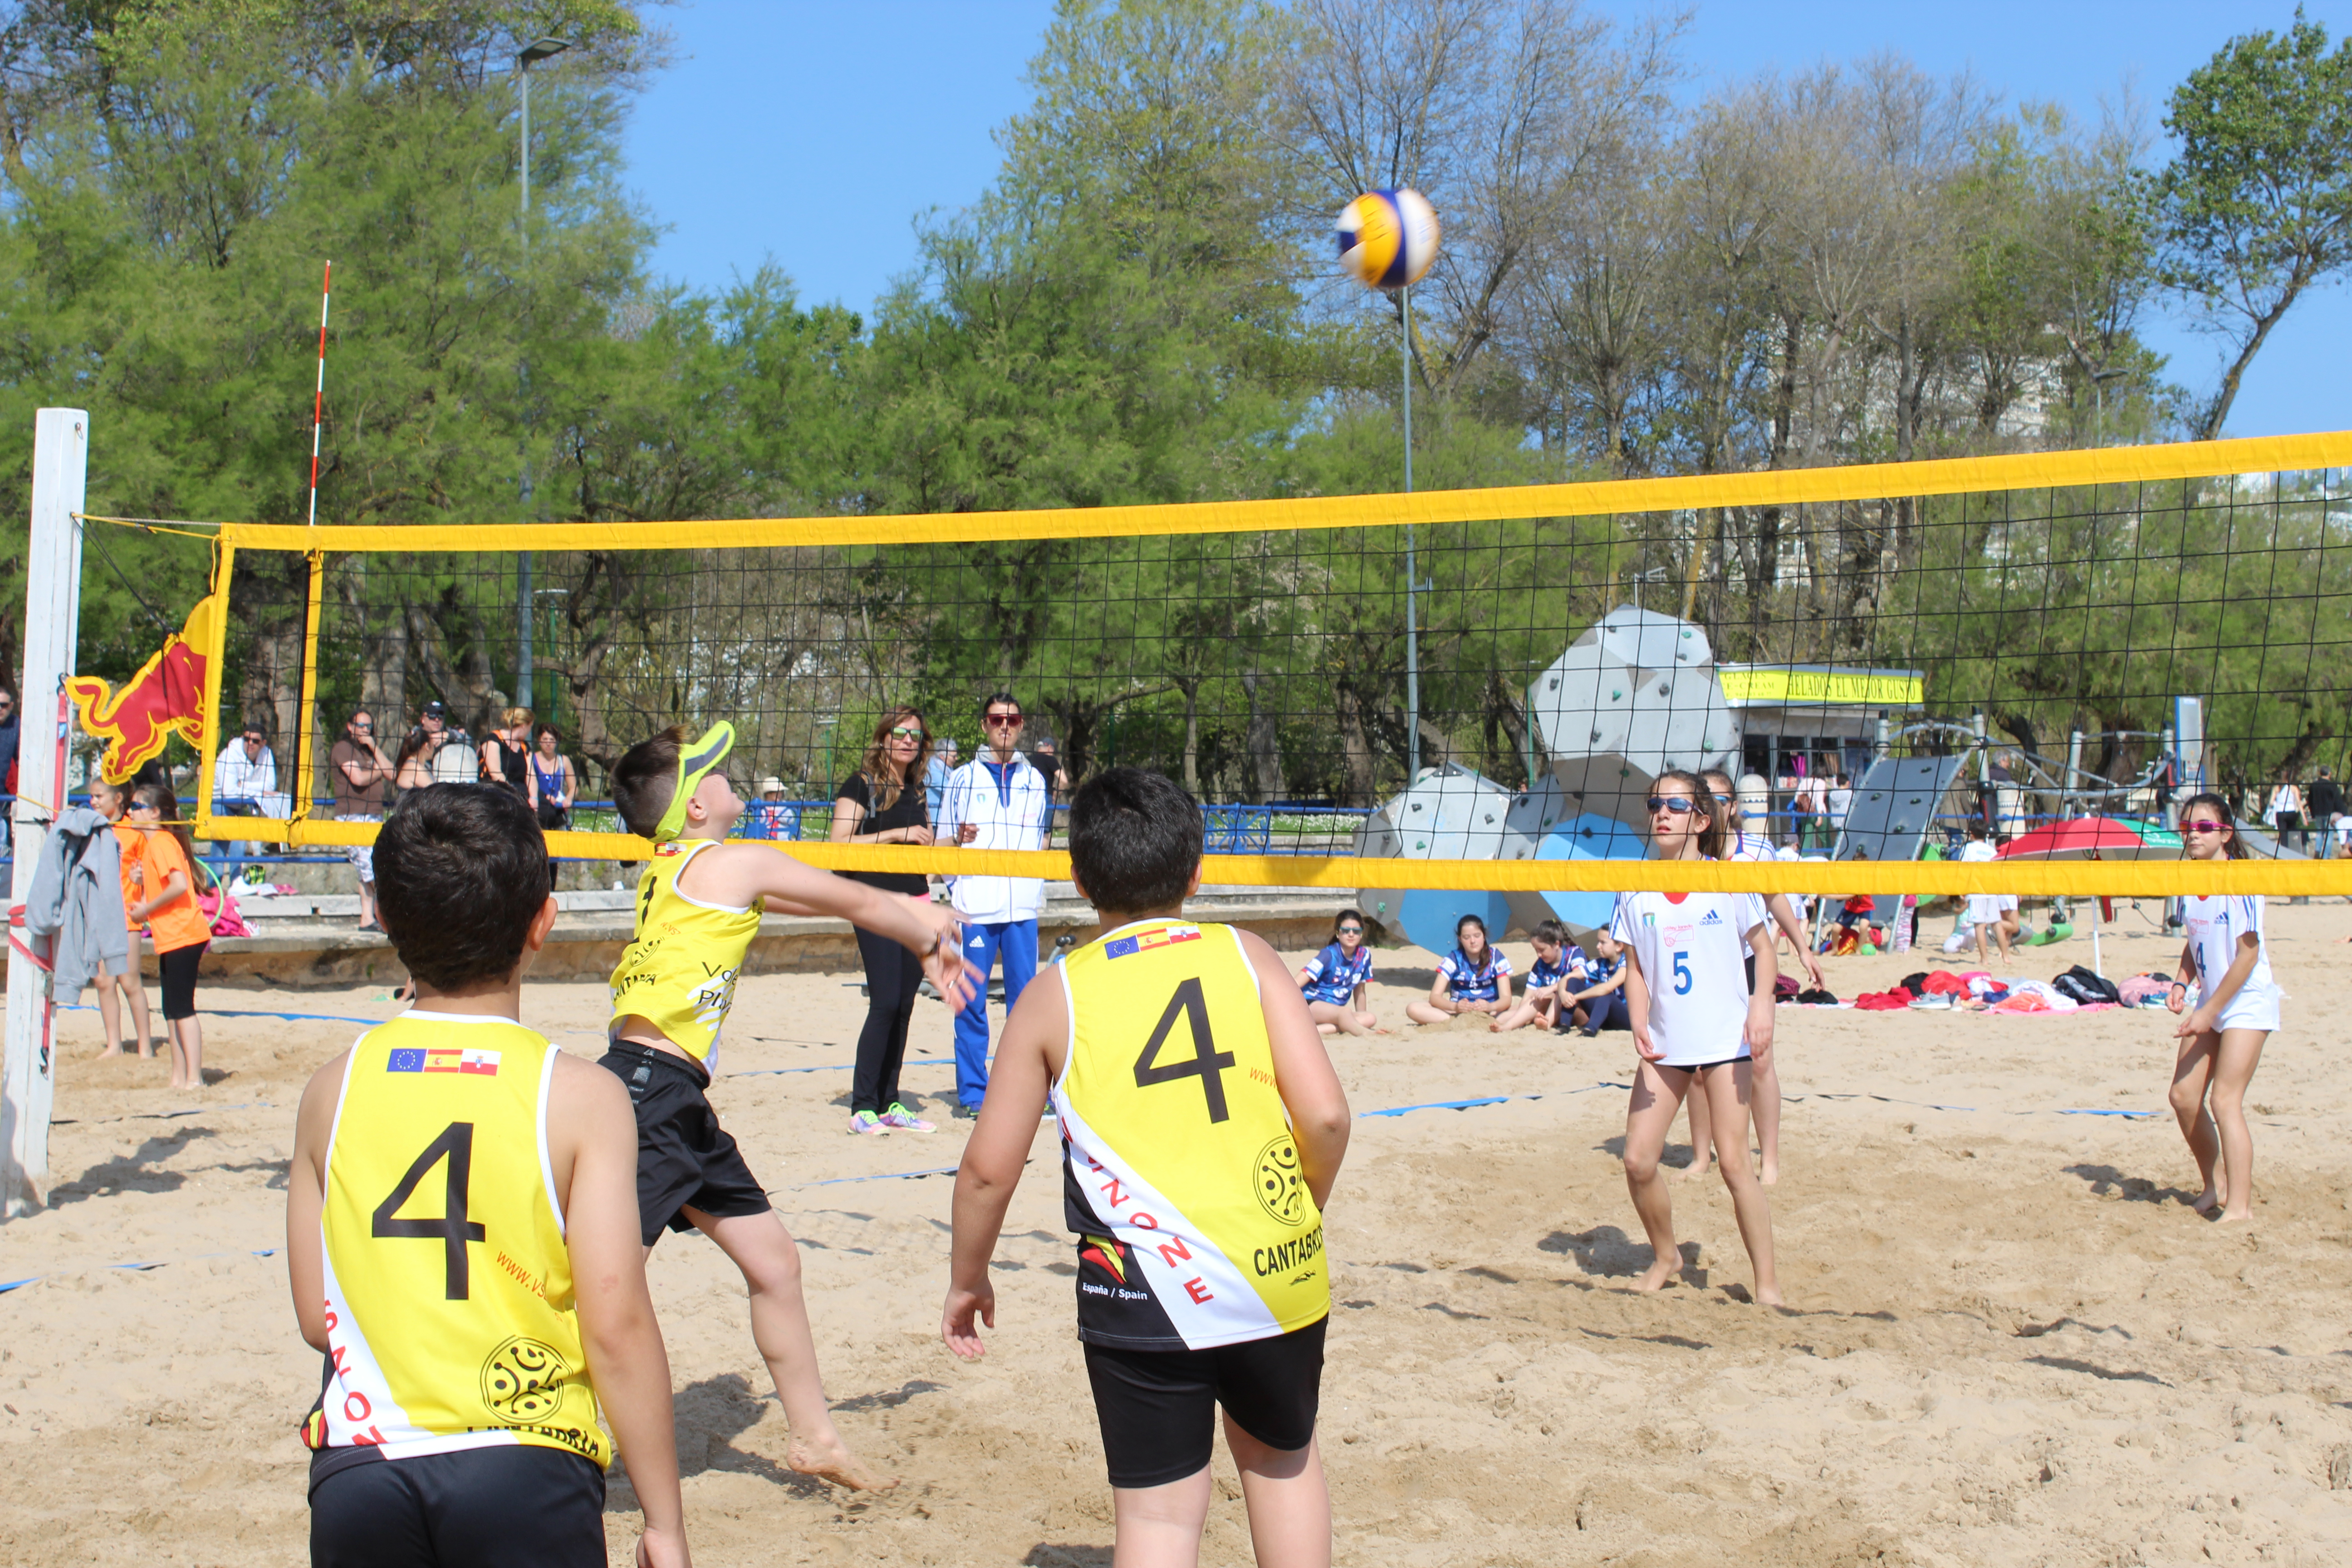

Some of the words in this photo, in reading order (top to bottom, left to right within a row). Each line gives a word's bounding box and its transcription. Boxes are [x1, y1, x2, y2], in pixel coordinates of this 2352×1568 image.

[1788, 675, 1832, 696] HELADOS
[1836, 676, 1848, 697] EL
[1851, 677, 1883, 699] MEJOR
[1886, 679, 1916, 701] GUSTO
[1673, 951, 1692, 995] 5
[2196, 942, 2206, 977] 4
[1133, 977, 1235, 1124] 4
[372, 1122, 485, 1300] 4
[497, 1250, 548, 1302] www.vs
[1082, 1282, 1108, 1296] España
[1110, 1287, 1116, 1298] /
[1118, 1288, 1148, 1301] Spain
